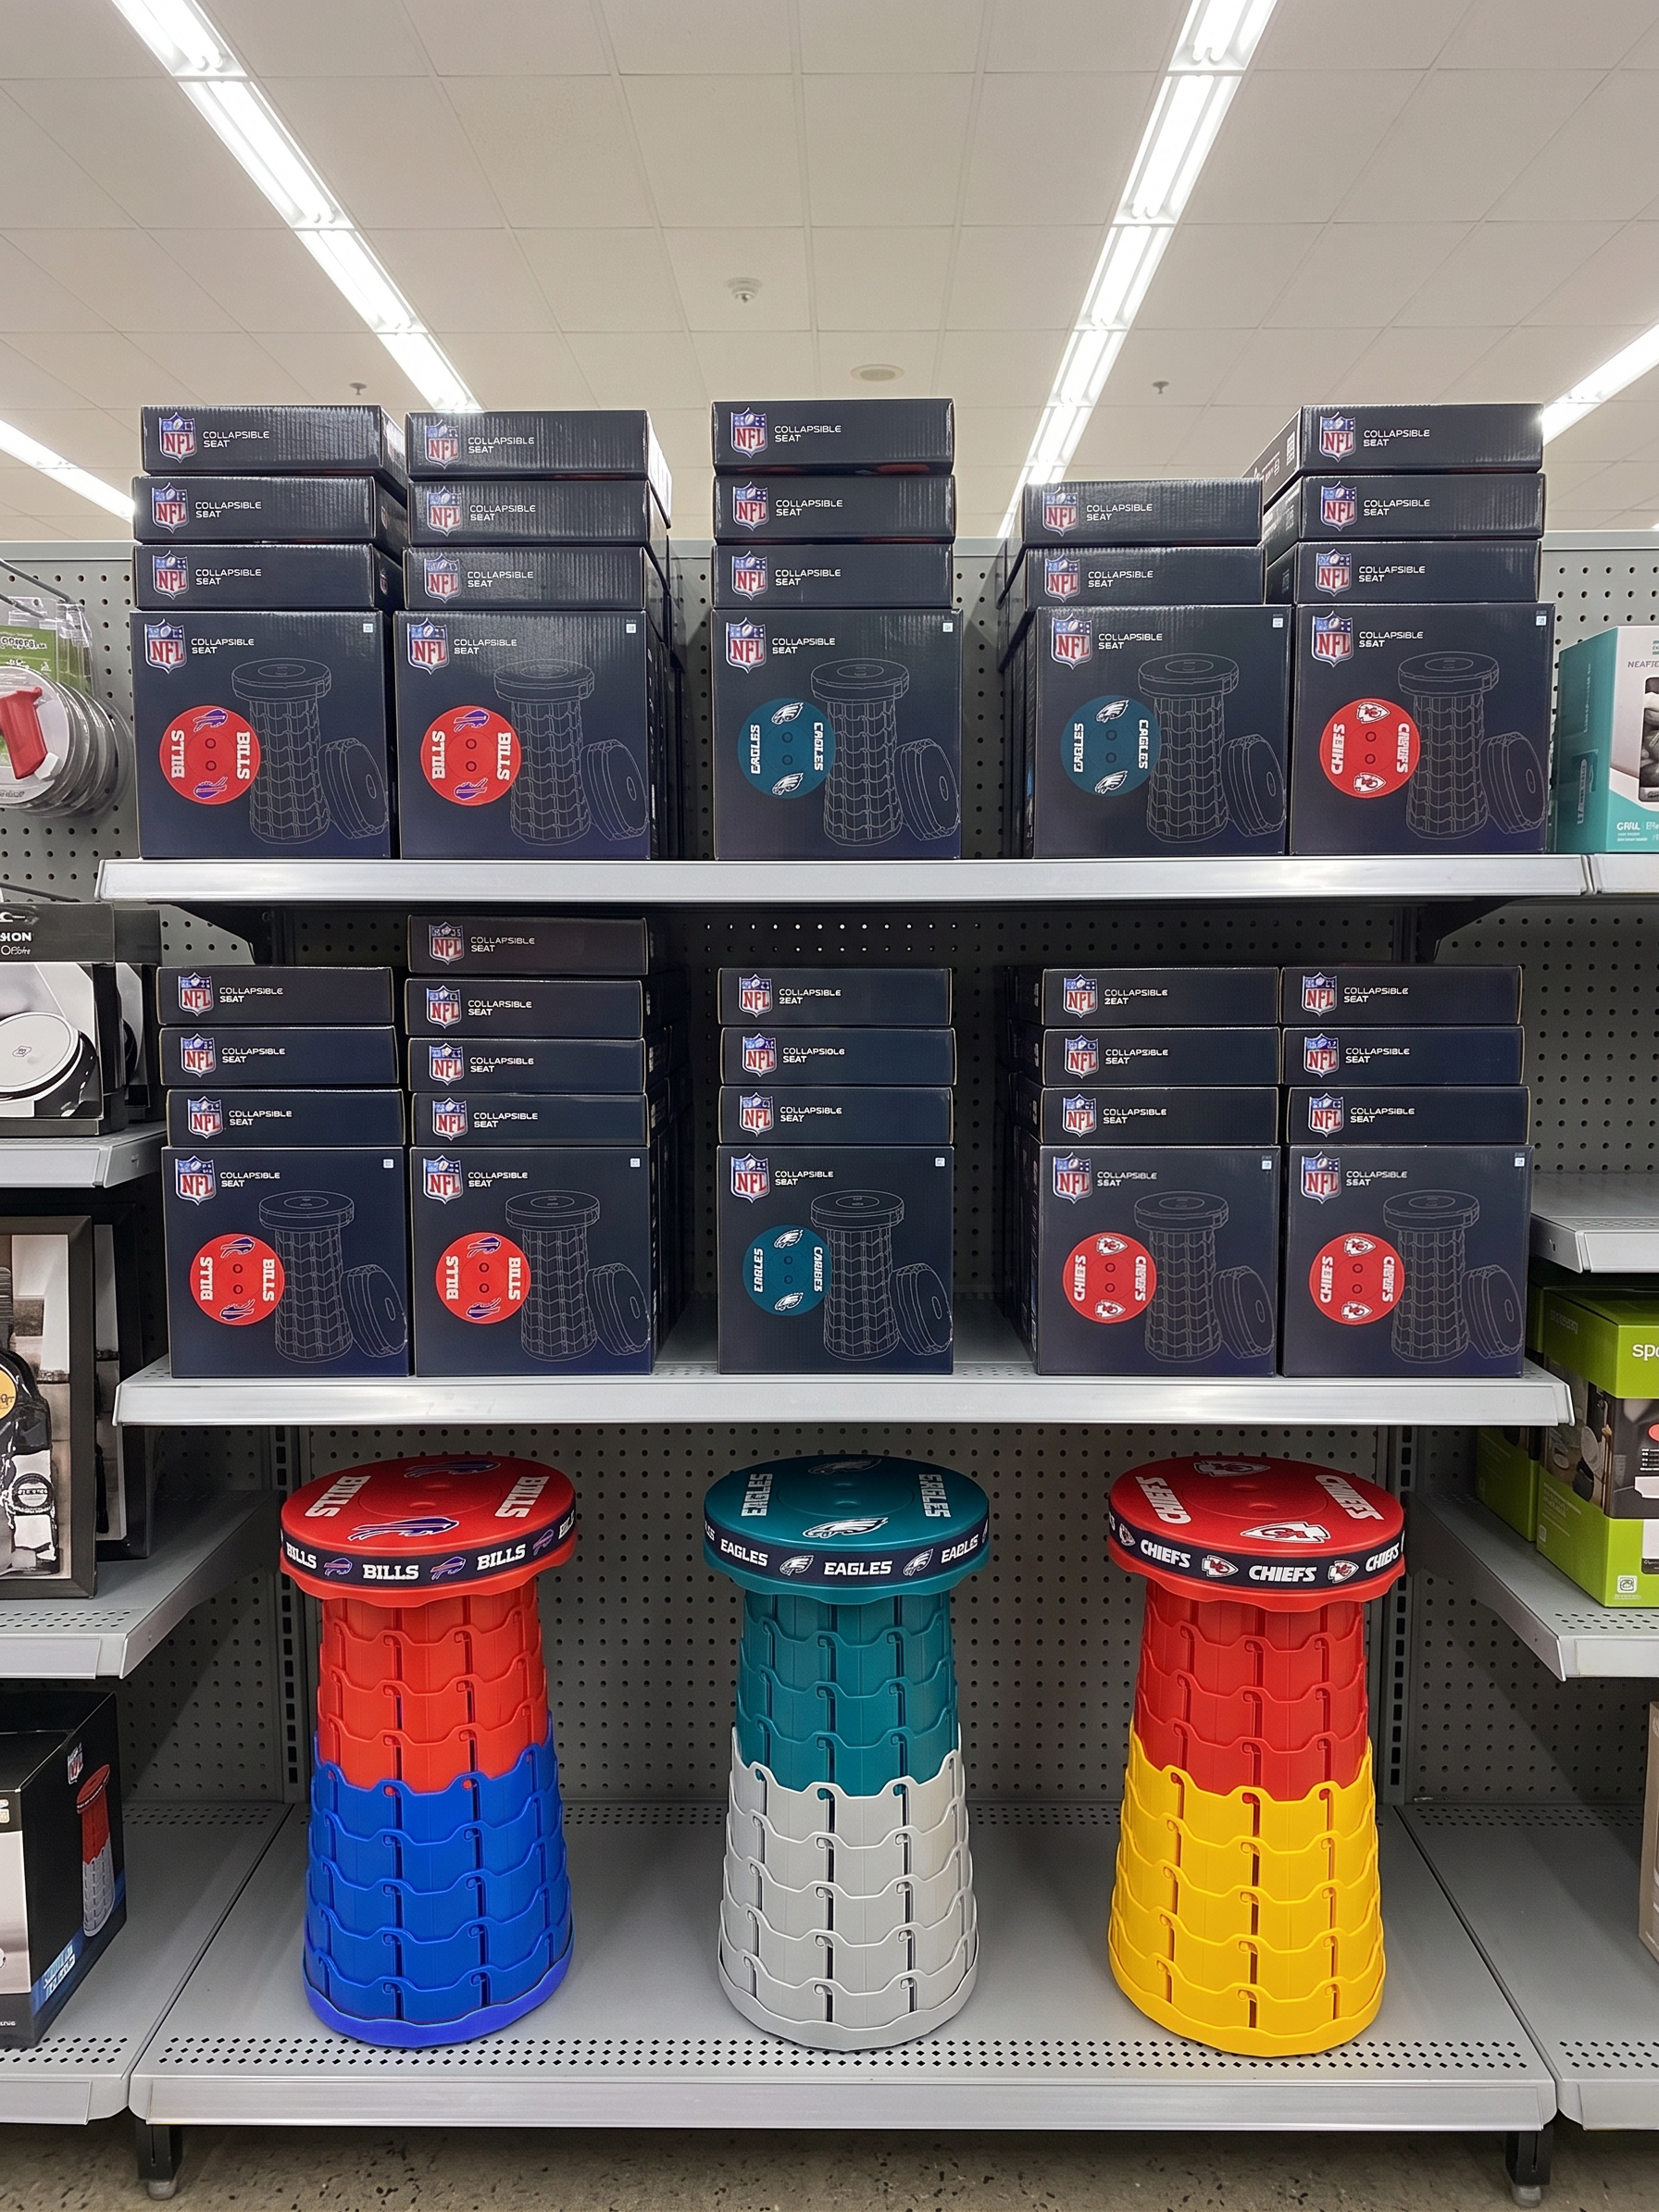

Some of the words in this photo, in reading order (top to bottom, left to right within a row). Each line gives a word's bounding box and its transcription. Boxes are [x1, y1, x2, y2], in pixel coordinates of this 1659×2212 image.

[774, 425, 842, 433] COLLAPSIBLE
[1364, 429, 1430, 438] COLLAPSIBLE
[775, 434, 801, 442] SEAT
[1363, 439, 1390, 447] SEAT
[1364, 499, 1430, 507] COLLAPSIBLE
[469, 504, 536, 513] COLLAPSIBLE
[776, 508, 802, 516] SEAT
[195, 510, 221, 518] SEAT
[468, 579, 493, 588] SEAT
[1088, 579, 1114, 588] SEAT
[1098, 633, 1163, 641] COLLAPSIBLE
[771, 638, 836, 646] COLLAPSIBLE
[171, 729, 185, 778] BILLS
[236, 731, 251, 780] BILLS
[431, 730, 445, 779] BILLS
[496, 732, 512, 780] BILLS
[470, 937, 535, 945] COLLAPSIBLE
[779, 988, 842, 997] COLLAPSIBLE
[1343, 987, 1409, 995] COLLAPSIBLE
[1343, 995, 1369, 1003] SEAT
[468, 1008, 493, 1016] SEAT
[469, 1057, 534, 1065] COLLAPSIBLE
[782, 1055, 807, 1063] SEAT
[1345, 1055, 1371, 1063] SEAT
[780, 1106, 842, 1114] COLLAPSIBLE
[1103, 1108, 1167, 1116] COLLAPSIBLE
[1350, 1107, 1416, 1115] COLLAPSIBLE
[229, 1118, 254, 1126] SEAT
[473, 1120, 499, 1128] SEAT
[1103, 1116, 1128, 1125] SEAT
[1350, 1115, 1376, 1124] SEAT
[200, 1257, 213, 1301] BILLS
[262, 1259, 275, 1301] BILLS
[445, 1256, 459, 1300] BILLS
[507, 1257, 521, 1300] BILLS
[286, 1541, 317, 1570] BILLS
[720, 1538, 768, 1567] EAGLES
[1140, 1539, 1191, 1569] CHIEFS
[476, 1544, 526, 1571] BILLS
[362, 1564, 419, 1581] BILLS
[823, 1560, 892, 1576] EAGLES
[1248, 1564, 1317, 1583] CHIEFS
